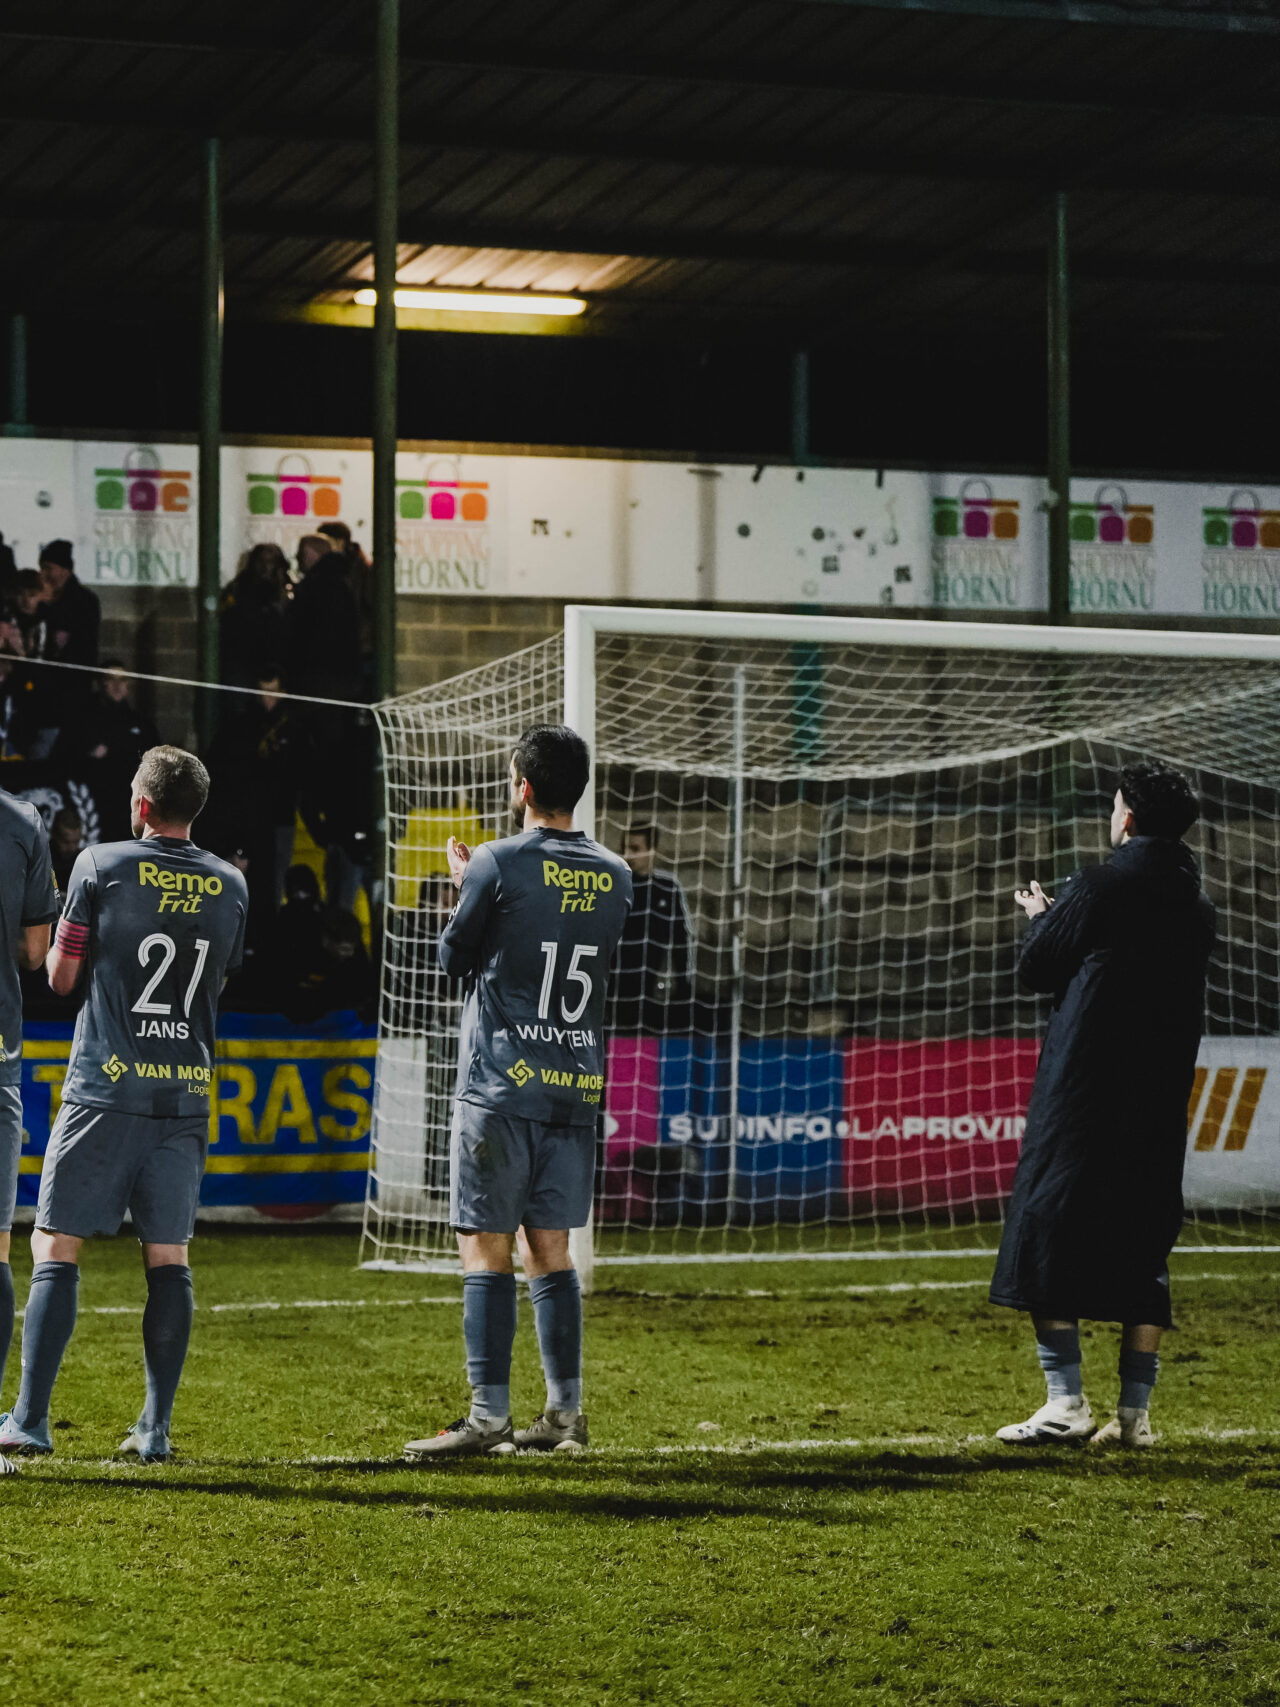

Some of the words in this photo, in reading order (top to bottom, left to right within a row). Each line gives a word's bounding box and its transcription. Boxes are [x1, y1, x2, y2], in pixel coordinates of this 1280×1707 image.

[95, 549, 191, 583] HORNU
[395, 557, 488, 590] HORNU
[1200, 555, 1280, 586] SHOPPIN
[933, 574, 1018, 606] HORNU
[1069, 578, 1154, 610] HORNU
[138, 862, 223, 896] Remo
[542, 860, 613, 893] Remo
[157, 891, 203, 914] Frit
[560, 890, 597, 913] Frit
[131, 933, 210, 1019] 21
[537, 941, 599, 1024] 15
[136, 1020, 190, 1040] JANS
[516, 1024, 597, 1048] WUYTEN
[134, 1062, 172, 1079] VAN
[177, 1065, 211, 1083] MOE
[541, 1068, 573, 1087] VAN
[576, 1073, 604, 1091] MOE
